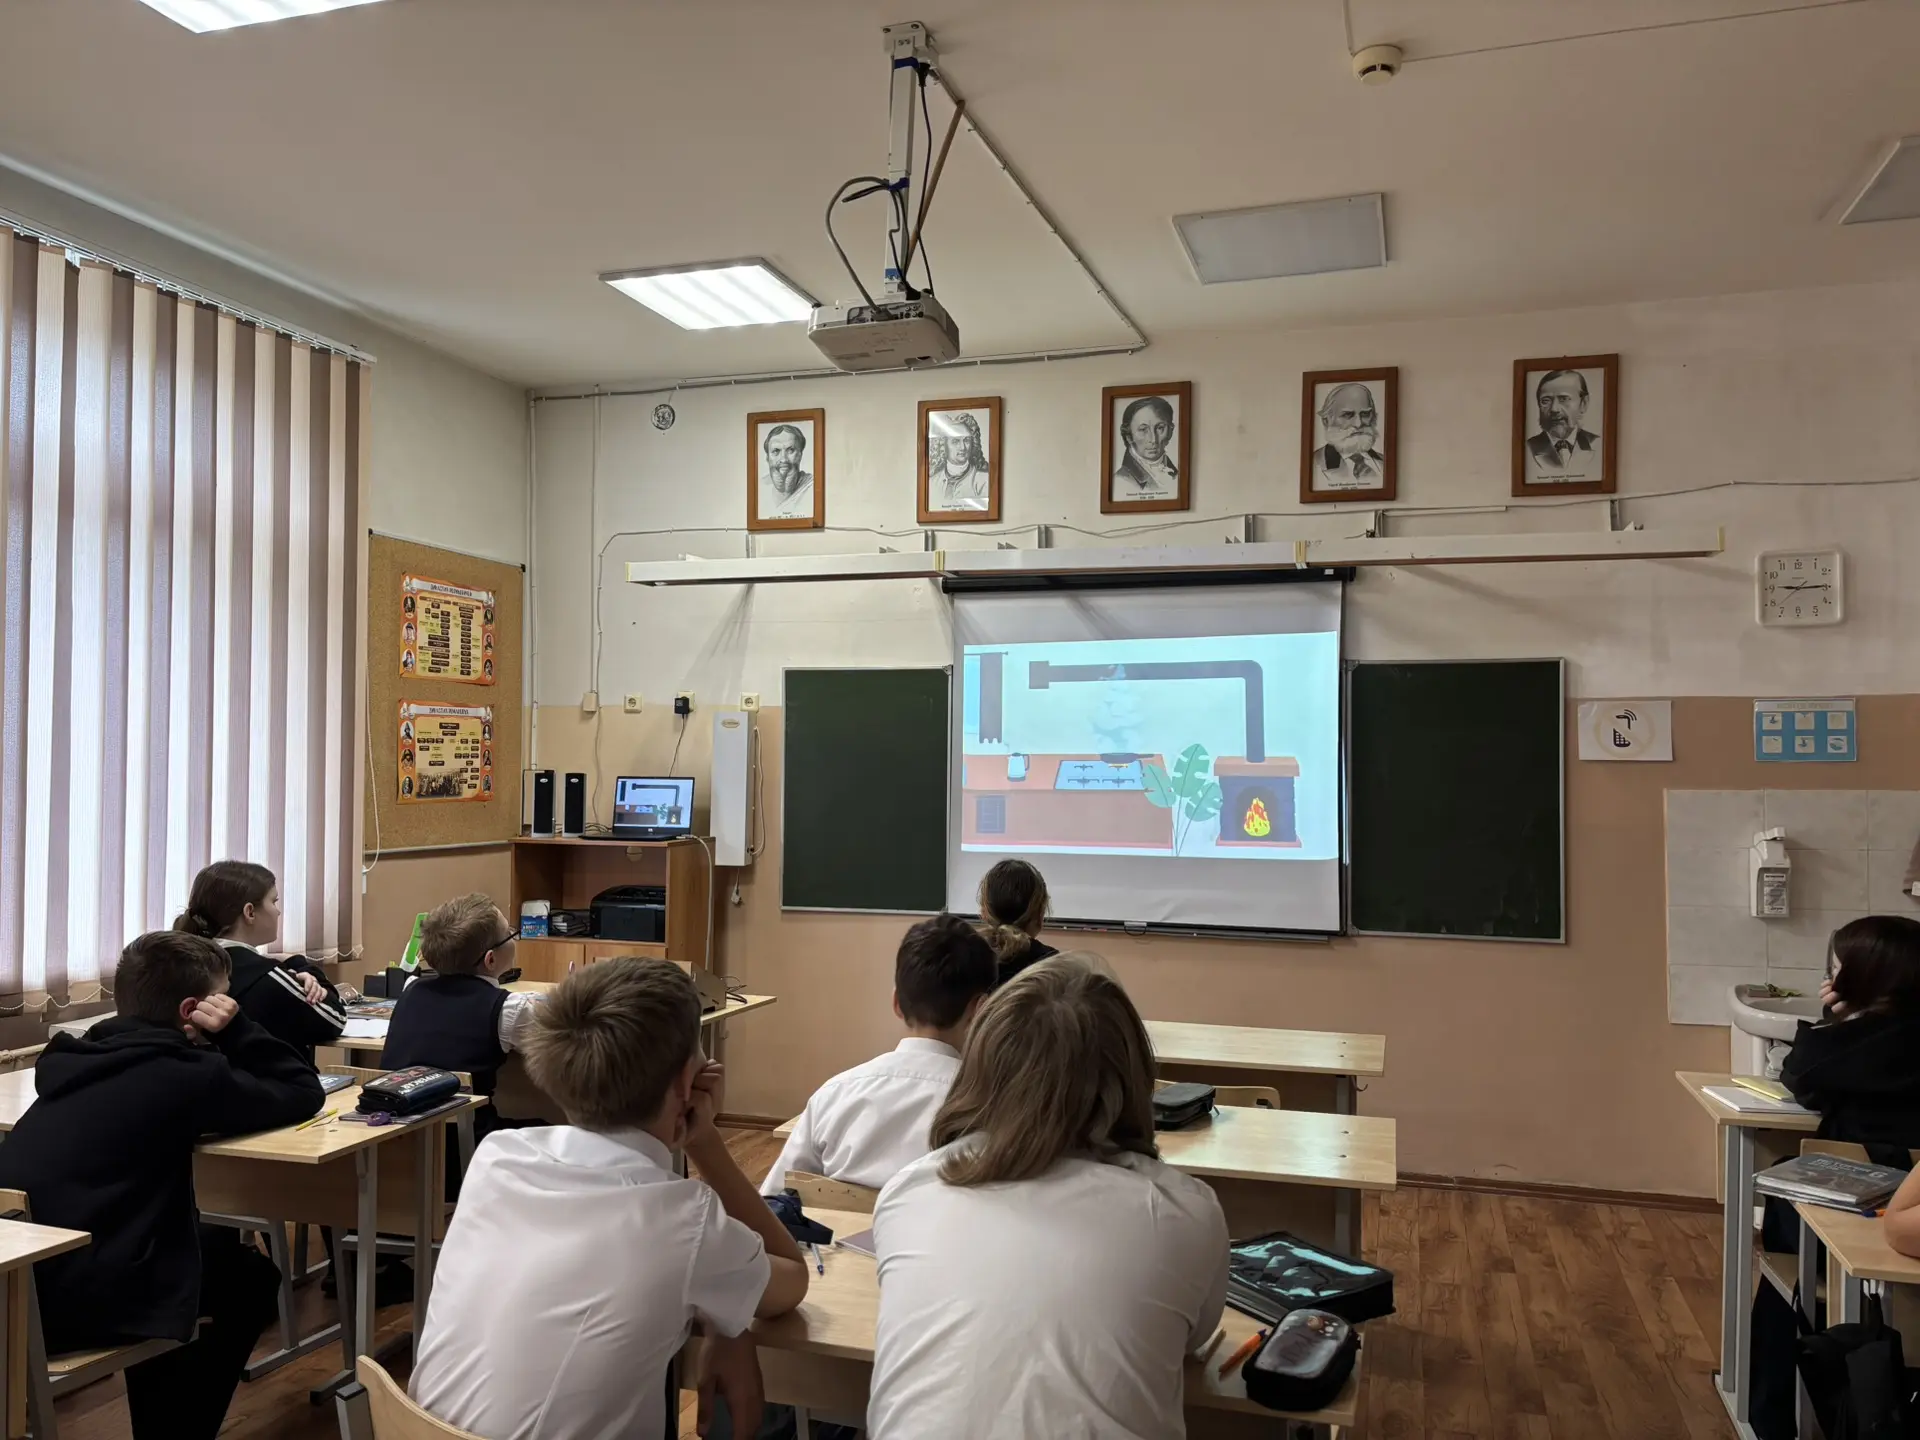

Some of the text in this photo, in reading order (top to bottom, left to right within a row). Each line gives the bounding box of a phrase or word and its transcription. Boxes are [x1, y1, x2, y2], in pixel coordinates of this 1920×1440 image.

[1779, 562, 1786, 571] 11
[1794, 562, 1803, 570] 12
[1769, 571, 1779, 580] 10
[1821, 567, 1828, 576] 2
[1768, 584, 1776, 593] 9
[1769, 599, 1777, 607] 8
[1822, 596, 1828, 604] 4
[1779, 606, 1785, 615] 7
[1795, 606, 1802, 614] 6
[1812, 605, 1819, 614] 5
